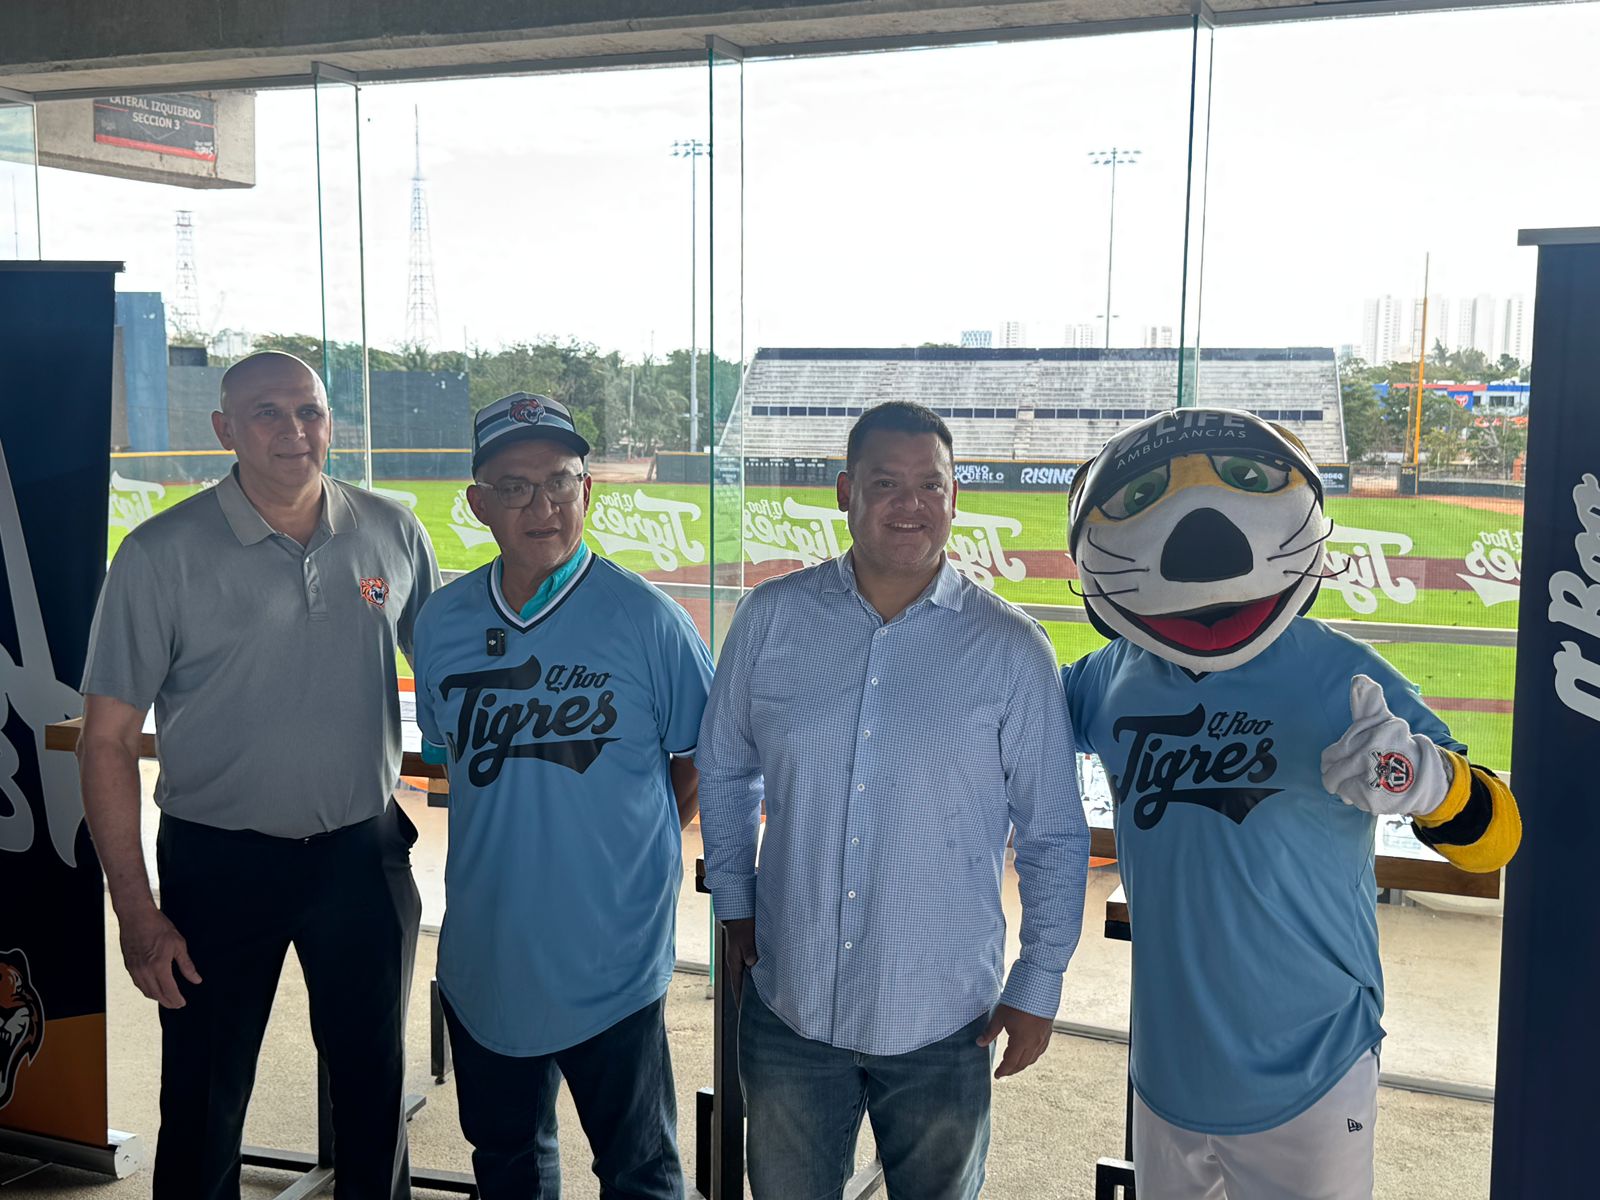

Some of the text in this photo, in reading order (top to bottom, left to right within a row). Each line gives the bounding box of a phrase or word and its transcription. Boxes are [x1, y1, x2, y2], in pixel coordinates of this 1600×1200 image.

[110, 96, 201, 119] LATERAL IZQUIERDO
[132, 112, 181, 130] SECCION 3
[1116, 429, 1247, 470] AMBULANCIAS
[545, 664, 612, 694] Q.Roo
[438, 655, 618, 788] Tigres
[1207, 711, 1274, 741] Q.Roo
[1112, 703, 1278, 831] Tigres
